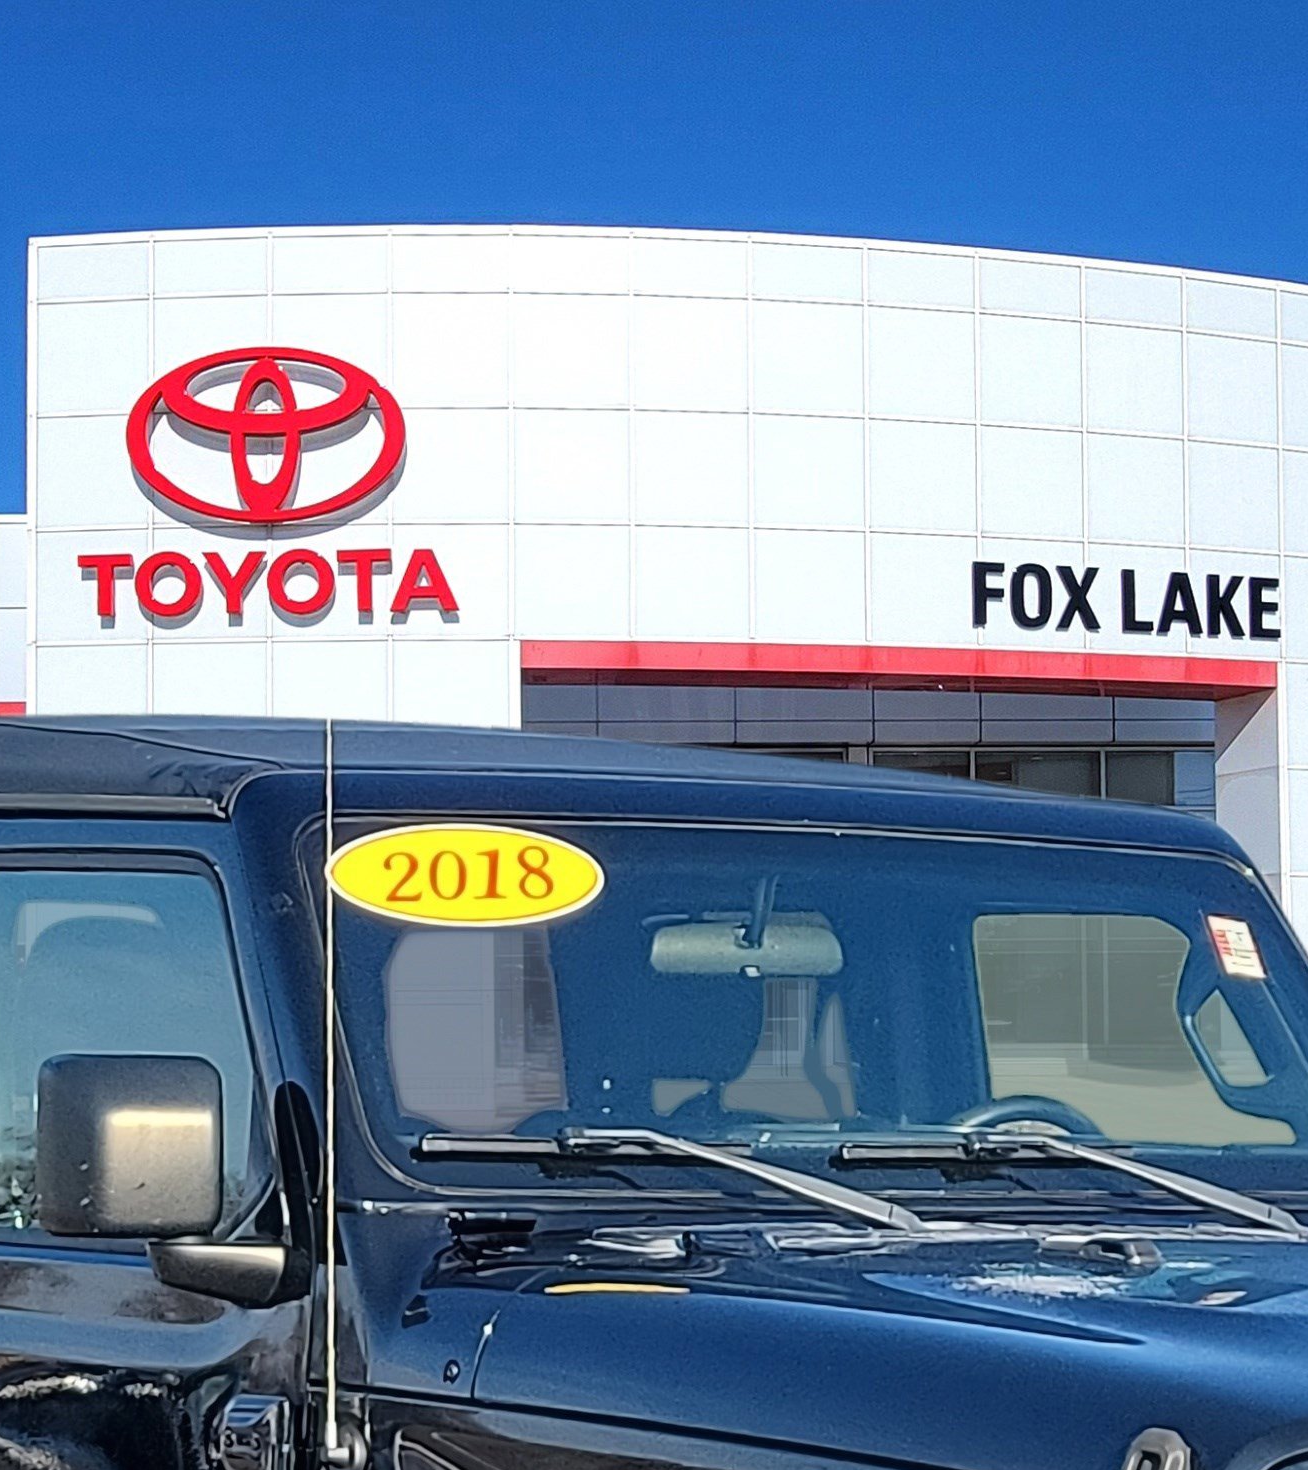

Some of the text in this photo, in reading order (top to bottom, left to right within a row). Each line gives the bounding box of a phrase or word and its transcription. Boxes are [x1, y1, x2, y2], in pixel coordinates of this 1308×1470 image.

[78, 549, 459, 617] TOYOTA
[972, 561, 1281, 639] FOX LAKE
[383, 846, 554, 902] 2018
